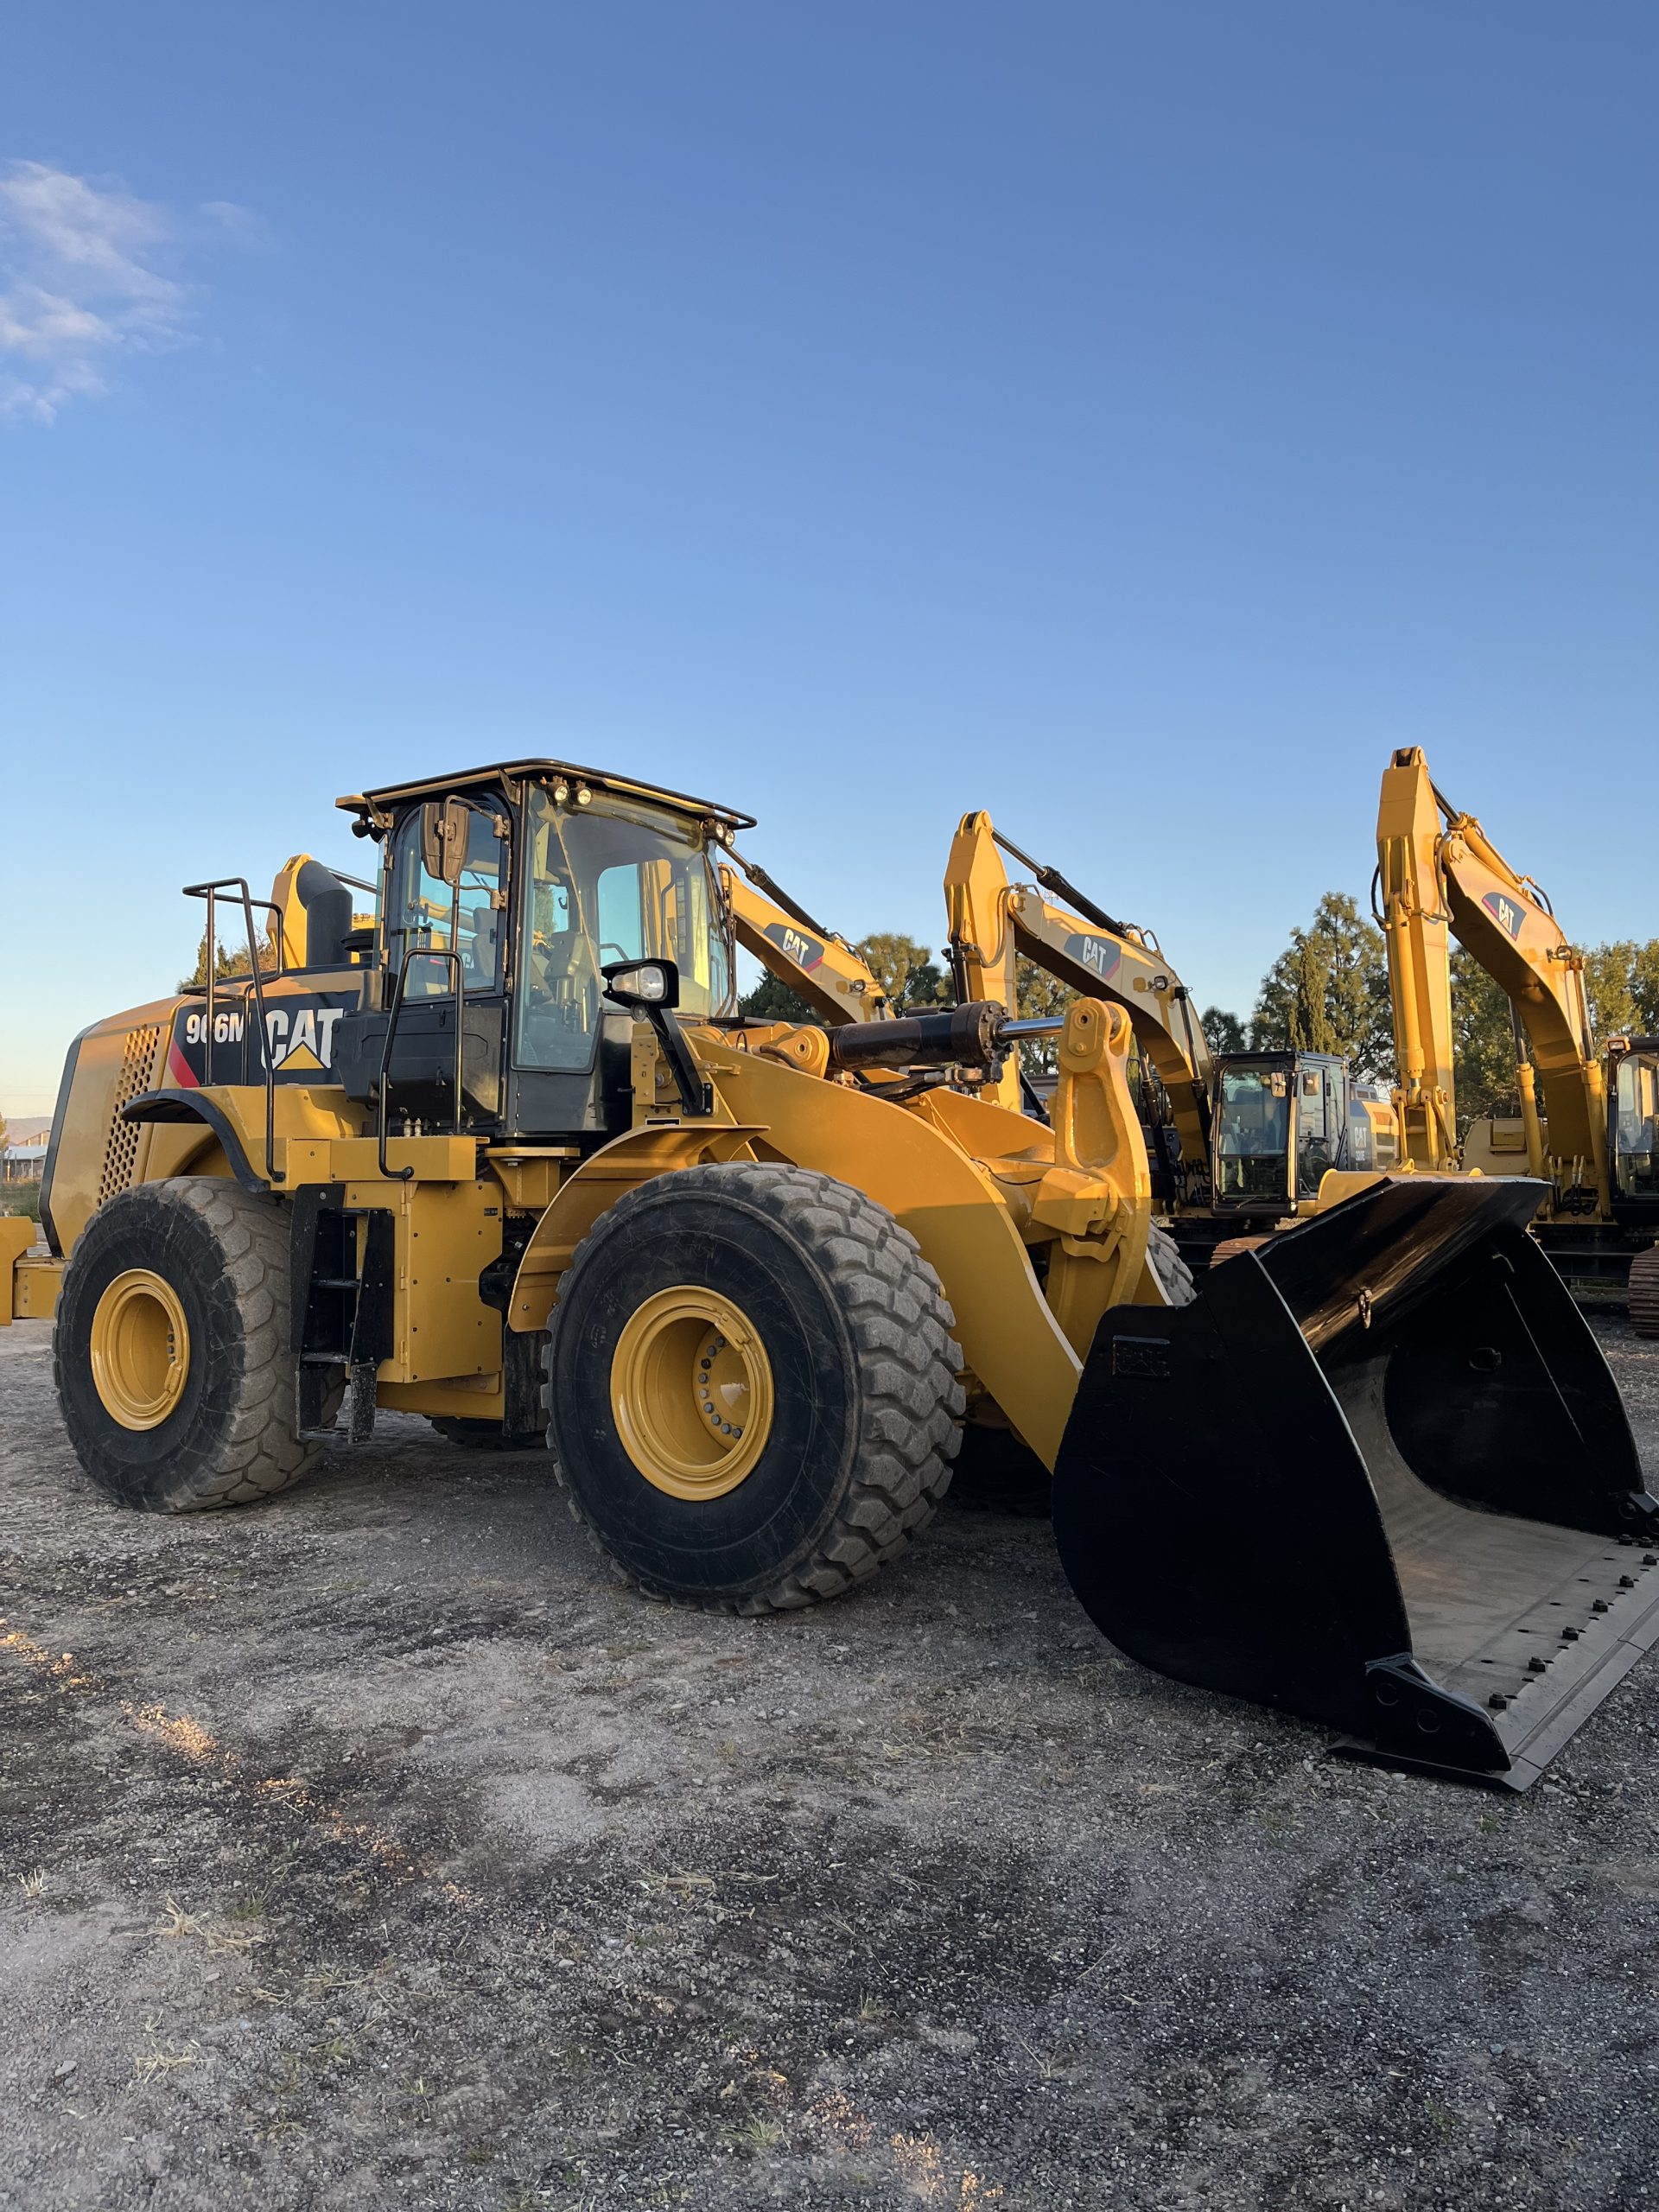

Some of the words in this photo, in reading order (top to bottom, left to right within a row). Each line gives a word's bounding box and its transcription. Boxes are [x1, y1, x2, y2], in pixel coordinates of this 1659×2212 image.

[1498, 898, 1515, 934] CAT
[782, 928, 810, 965] CAT
[1082, 936, 1107, 975] CAT
[261, 1008, 344, 1070] CAT
[1354, 1127, 1367, 1147] CAT
